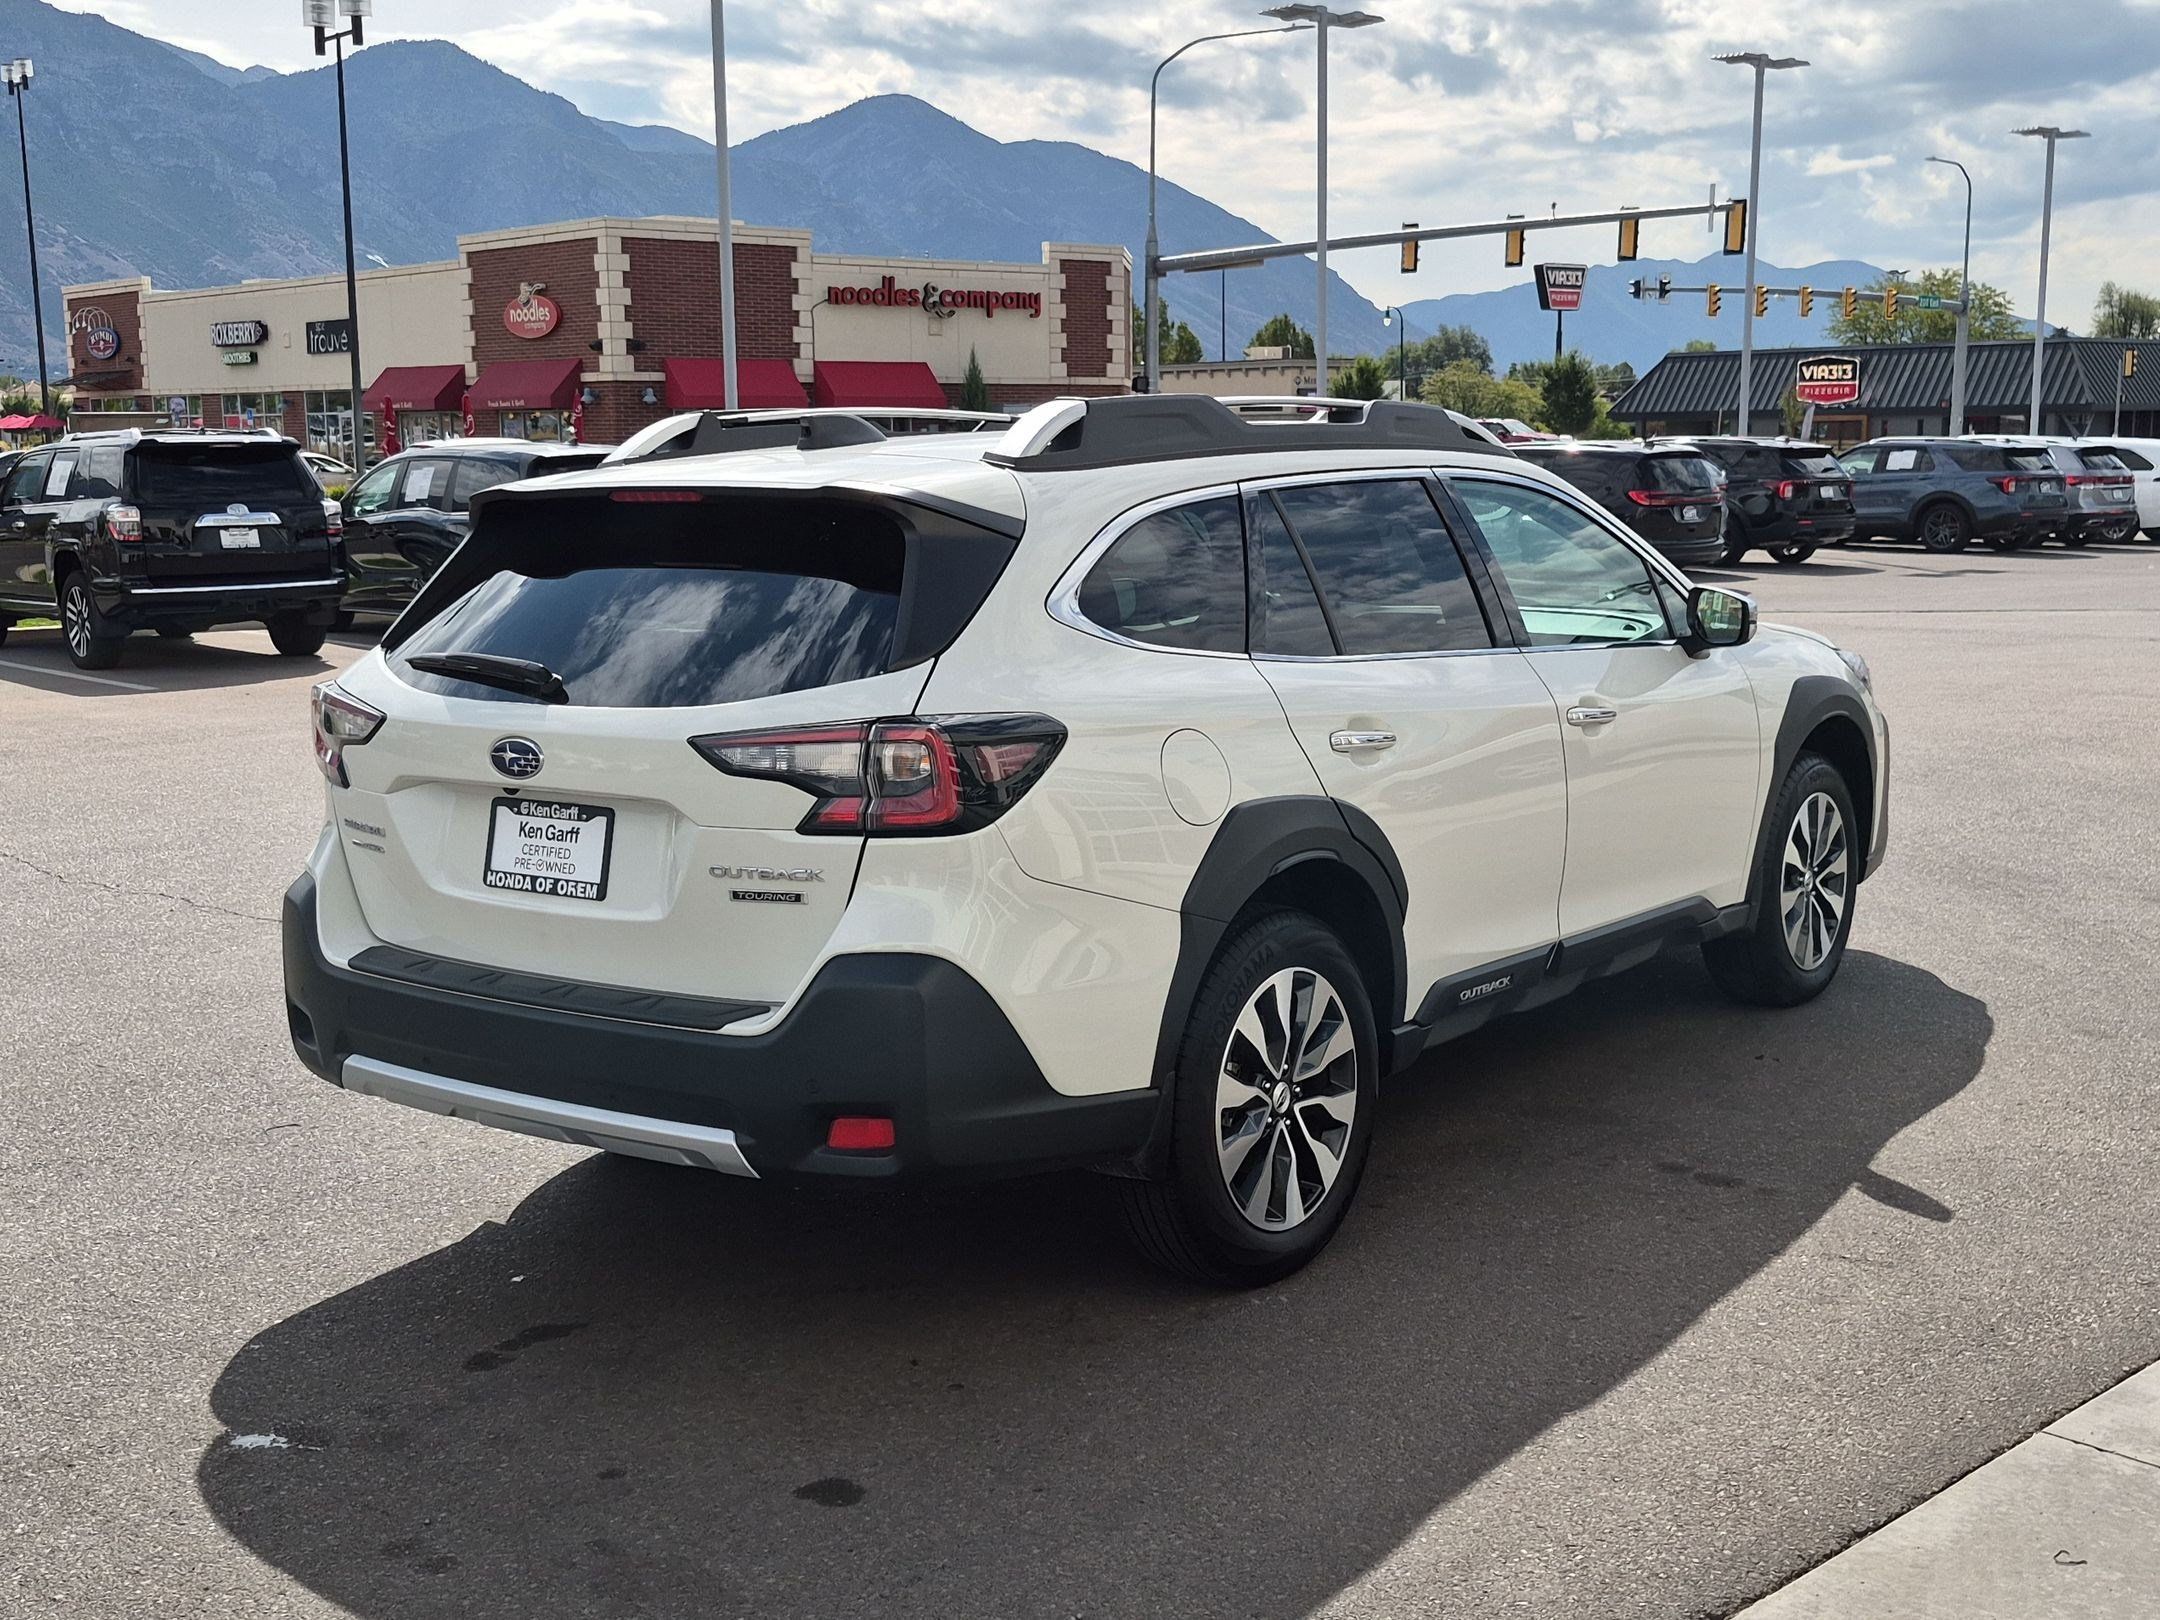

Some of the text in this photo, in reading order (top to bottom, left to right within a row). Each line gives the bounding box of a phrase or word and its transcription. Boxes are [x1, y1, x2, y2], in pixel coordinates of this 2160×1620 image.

[828, 276, 920, 307] noodles
[939, 289, 1041, 318] company
[509, 299, 551, 323] noodles
[210, 322, 256, 345] ROXBERRY
[1804, 387, 1850, 395] PIZZERIA
[529, 803, 579, 820] Ken Garff
[518, 821, 581, 844] Ken Garff
[521, 843, 571, 860] CERTIFIED
[486, 870, 599, 899] HONDA OF OREM
[708, 865, 826, 882] OUTBACK
[738, 892, 796, 901] TOURING
[1460, 976, 1511, 1001] OUTBACK
